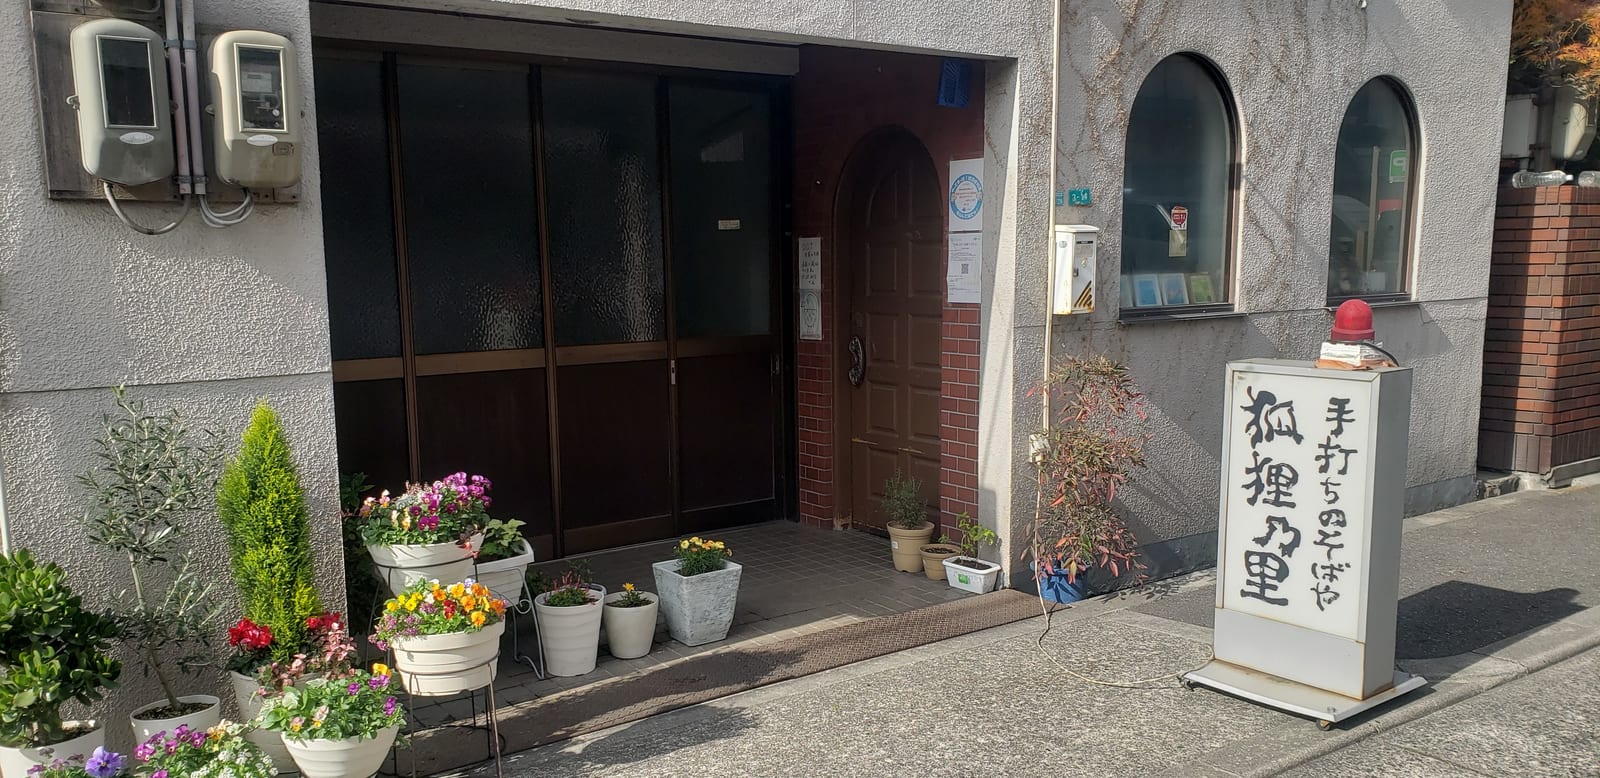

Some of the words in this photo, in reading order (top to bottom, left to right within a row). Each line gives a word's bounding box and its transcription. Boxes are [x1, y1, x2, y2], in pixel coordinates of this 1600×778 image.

[1240, 386, 1304, 606] 狐狸乃里
[1310, 397, 1357, 611] 手打ちのそばや
